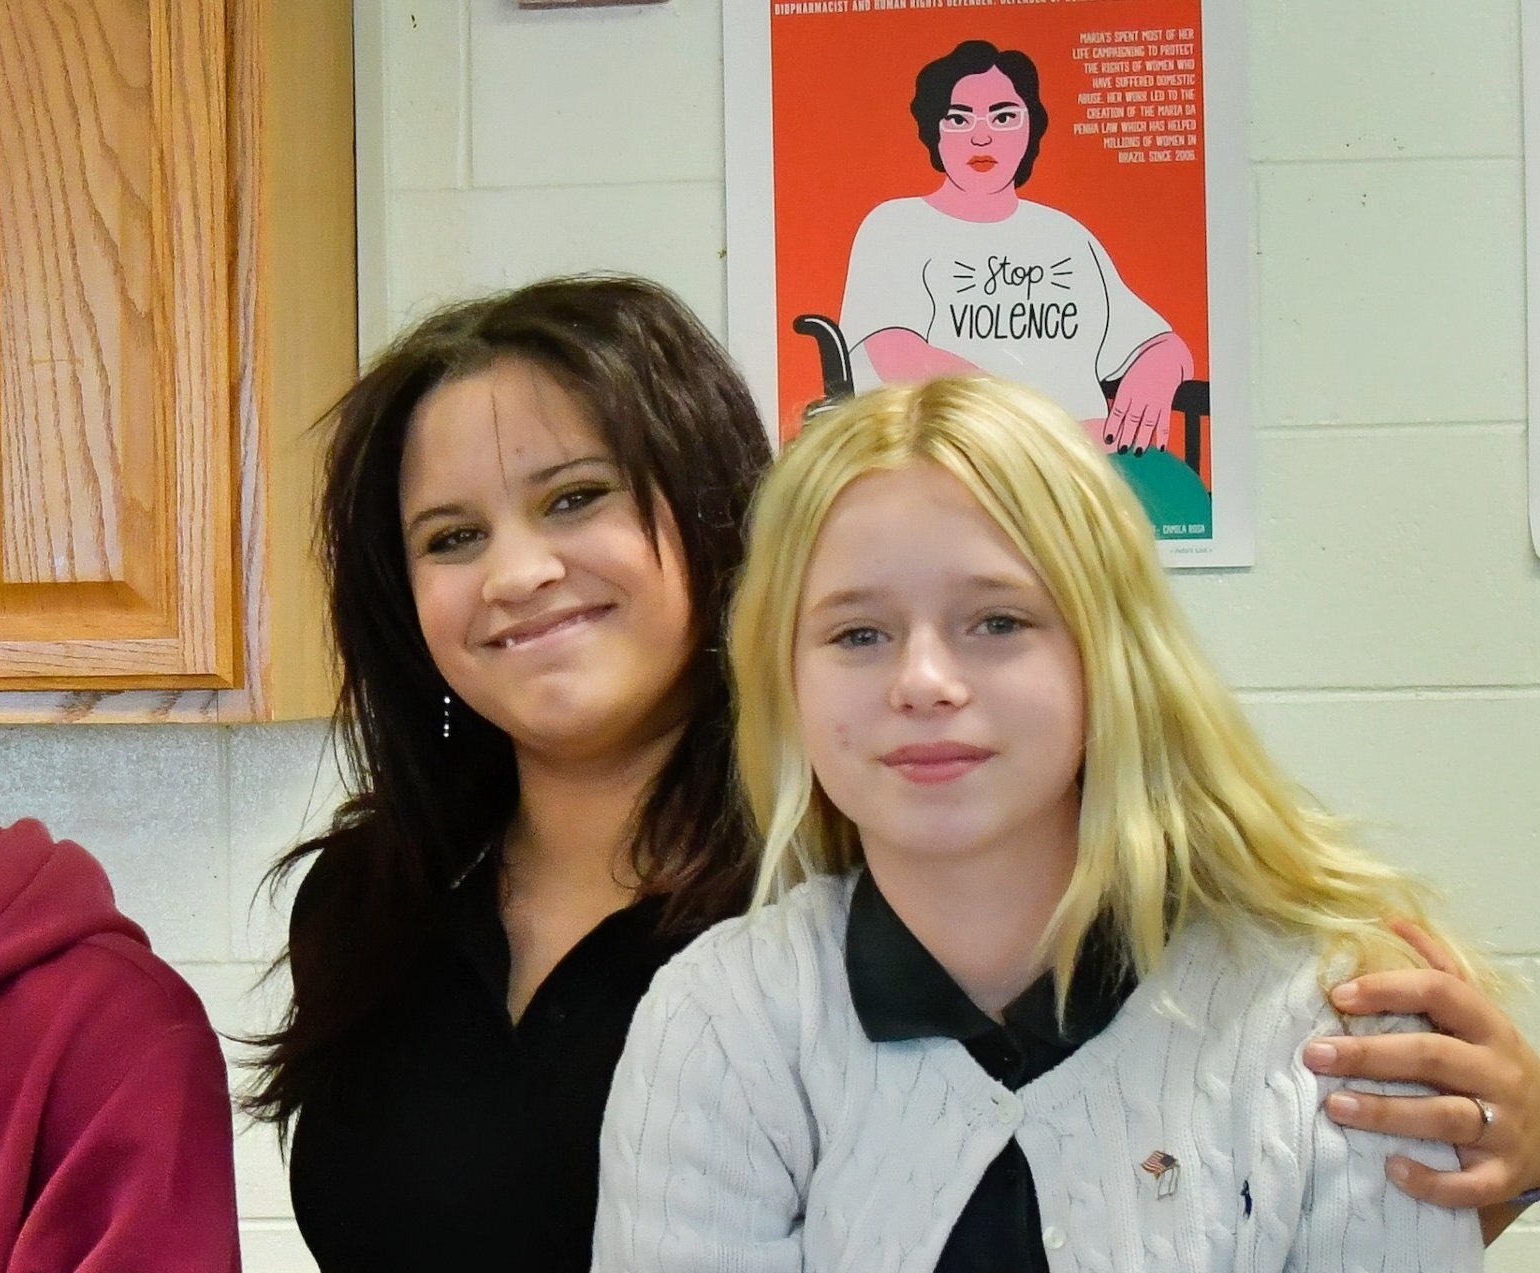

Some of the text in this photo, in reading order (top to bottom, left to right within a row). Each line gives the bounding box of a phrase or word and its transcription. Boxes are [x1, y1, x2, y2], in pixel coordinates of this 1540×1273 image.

[774, 1, 848, 15] BIOPHARMACIST
[852, 0, 871, 11] AND
[874, 0, 906, 10] HUMAN
[910, 0, 944, 8] RIGHTS
[1114, 30, 1139, 42] SPENT
[1141, 30, 1162, 41] MOST
[1165, 29, 1177, 40] OF
[1179, 28, 1194, 40] HER
[1072, 44, 1194, 59] LIFE CAMPAIGNING TO PROTECT
[1084, 59, 1195, 74] THE RIGHTS OF WOMEN WHO
[1092, 74, 1195, 88] HAVE SUFFERED DOMESTIC
[1107, 92, 1122, 103] HER
[1125, 91, 1147, 102] WORK
[1150, 90, 1165, 101] LED
[1168, 89, 1178, 101] TO
[1181, 89, 1196, 100] THE
[1087, 104, 1196, 119] CREATION OF THE MARIA DA
[1102, 122, 1118, 134] LAW
[1121, 121, 1147, 133] WHICH
[1149, 120, 1165, 132] HAS
[1167, 119, 1197, 131] HELPED
[1104, 134, 1197, 149] MILLIONS OF WOMEN IN
[1118, 151, 1146, 163] BRAZIL
[1149, 150, 1172, 162] SINCE
[983, 255, 1044, 300] Stop
